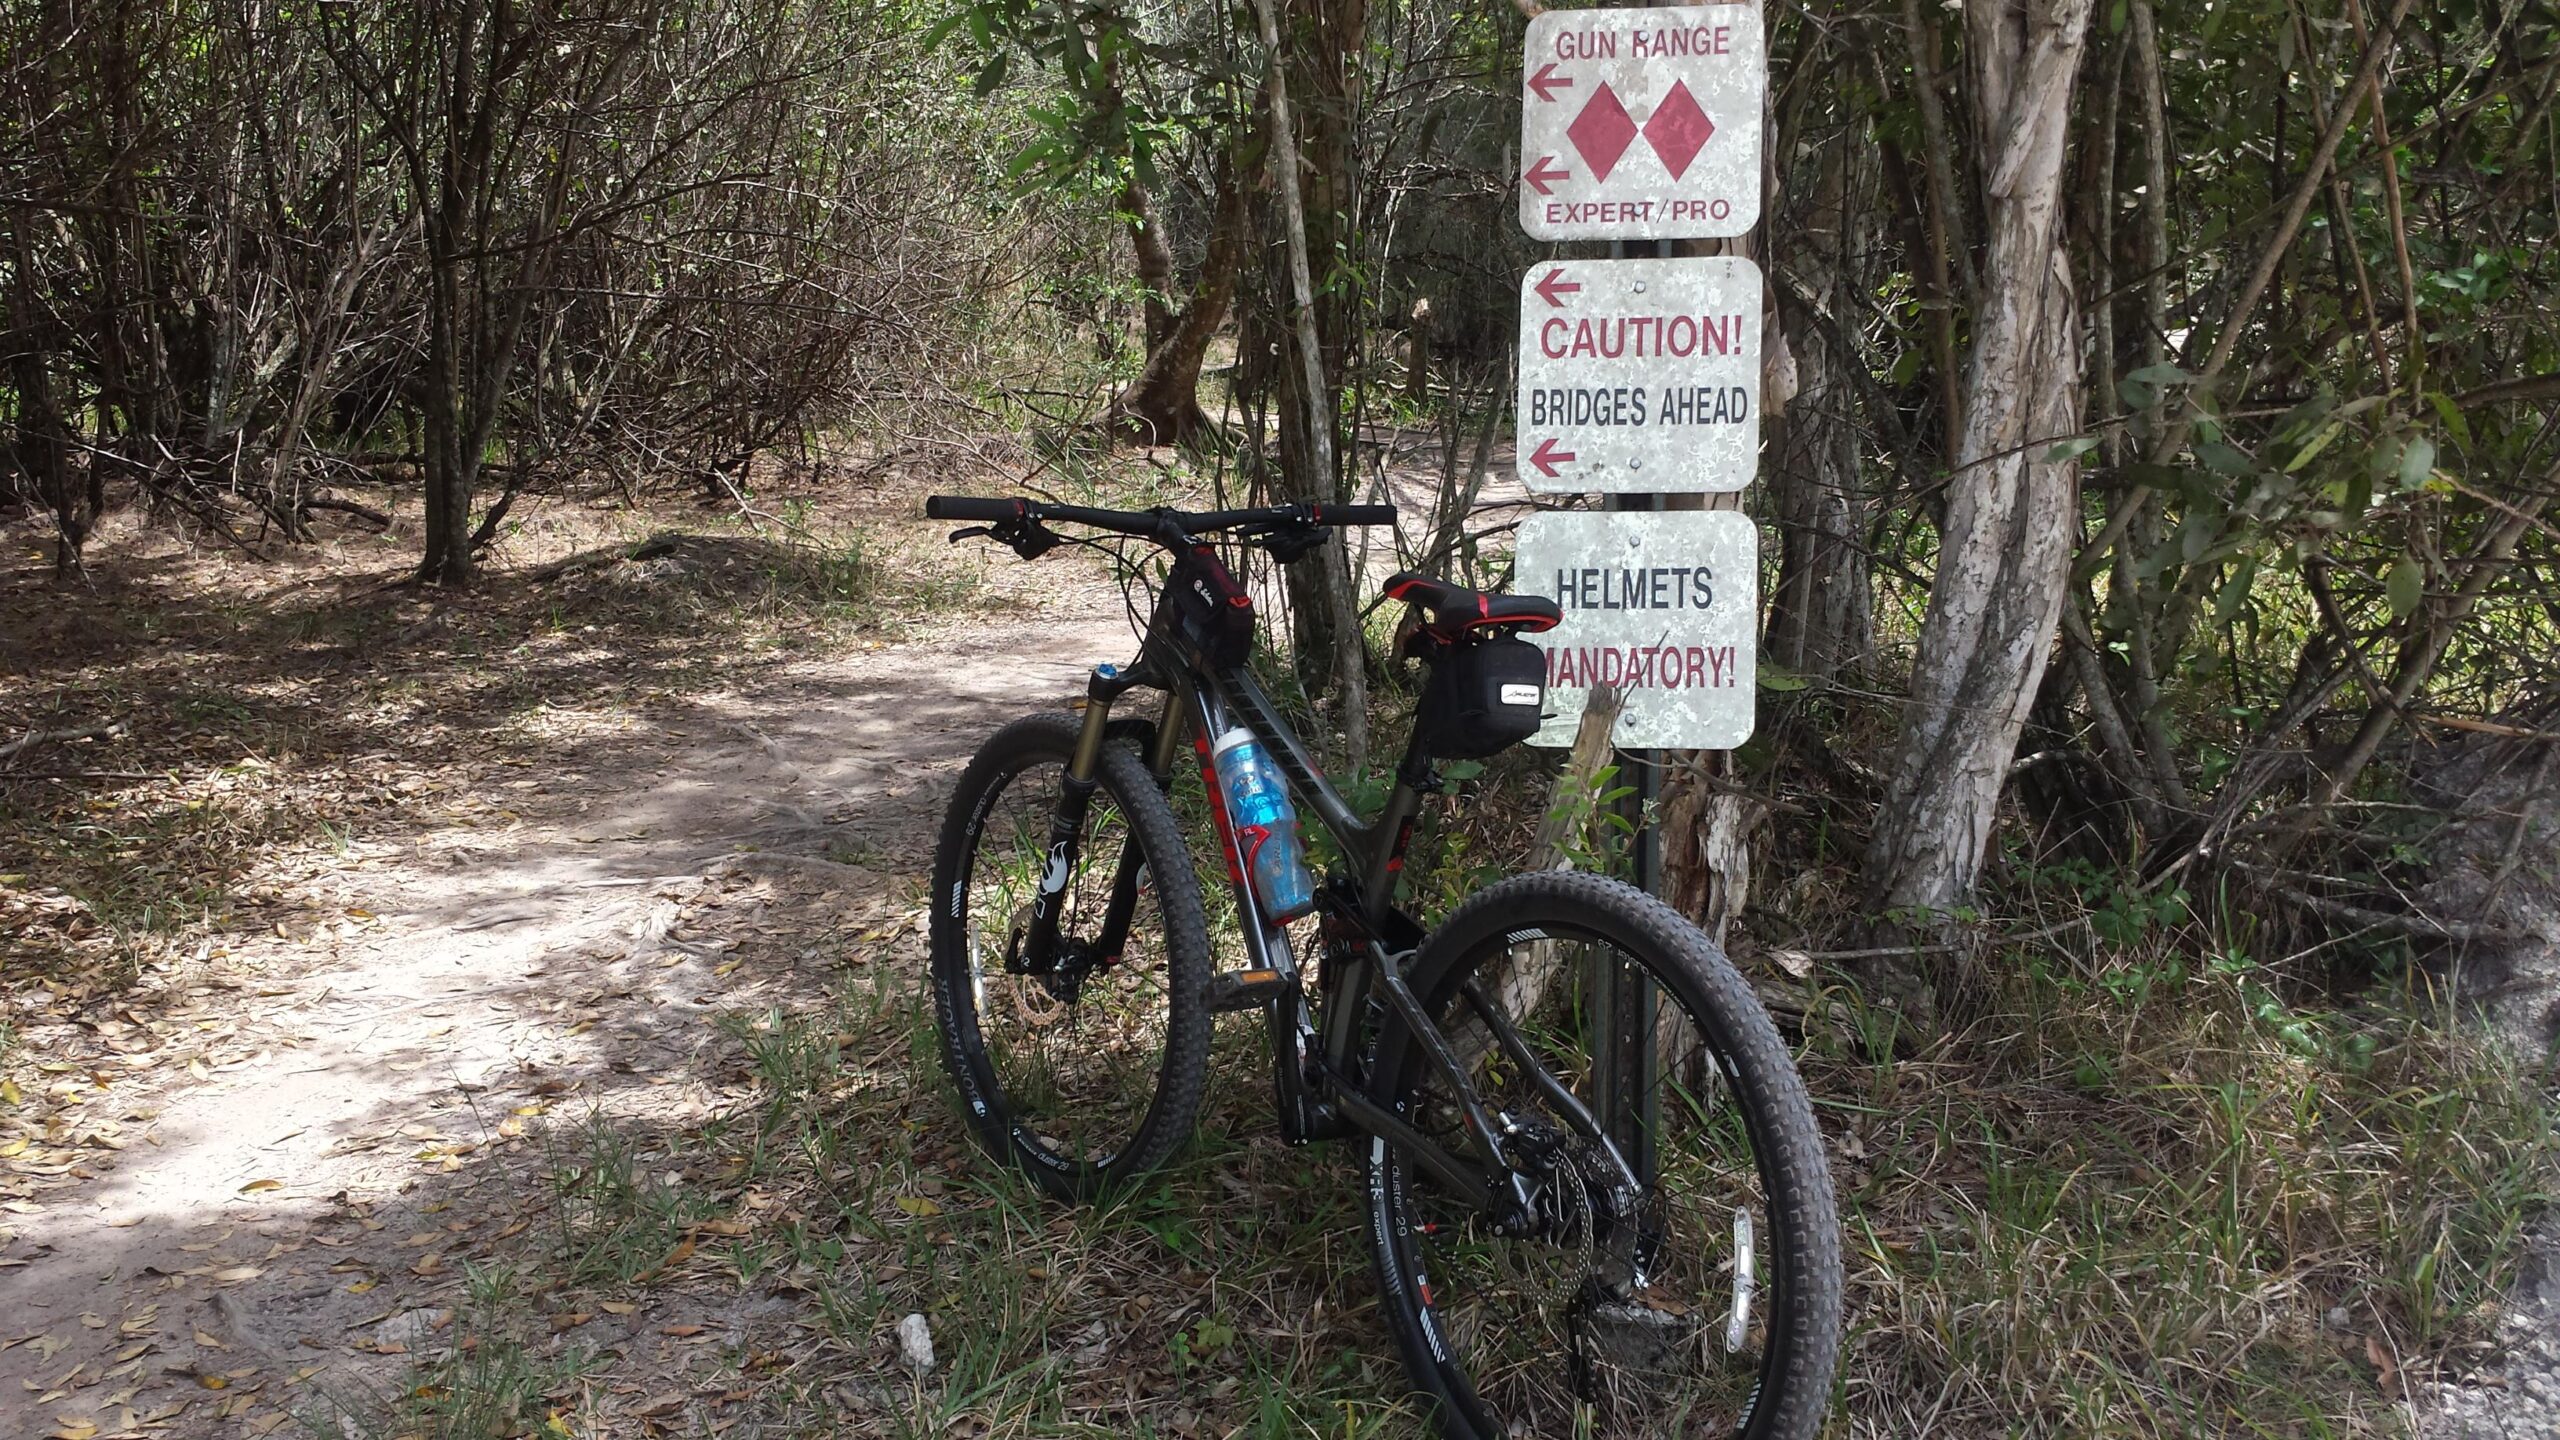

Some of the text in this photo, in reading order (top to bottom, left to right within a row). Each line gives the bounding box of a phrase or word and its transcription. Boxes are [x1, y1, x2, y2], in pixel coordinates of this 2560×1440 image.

[1556, 26, 1730, 60] GUN RANGE
[1546, 199, 1730, 224] EXPERT/PRO
[1541, 314, 1742, 359] CAUTION!
[1531, 386, 1748, 426] BRIDGES AHEAD
[1557, 566, 1713, 610] HELMETS
[1057, 1160, 1070, 1171] 29
[1391, 1165, 1403, 1210] duster
[1373, 1210, 1385, 1246] expert
[1395, 1216, 1408, 1237] 29
